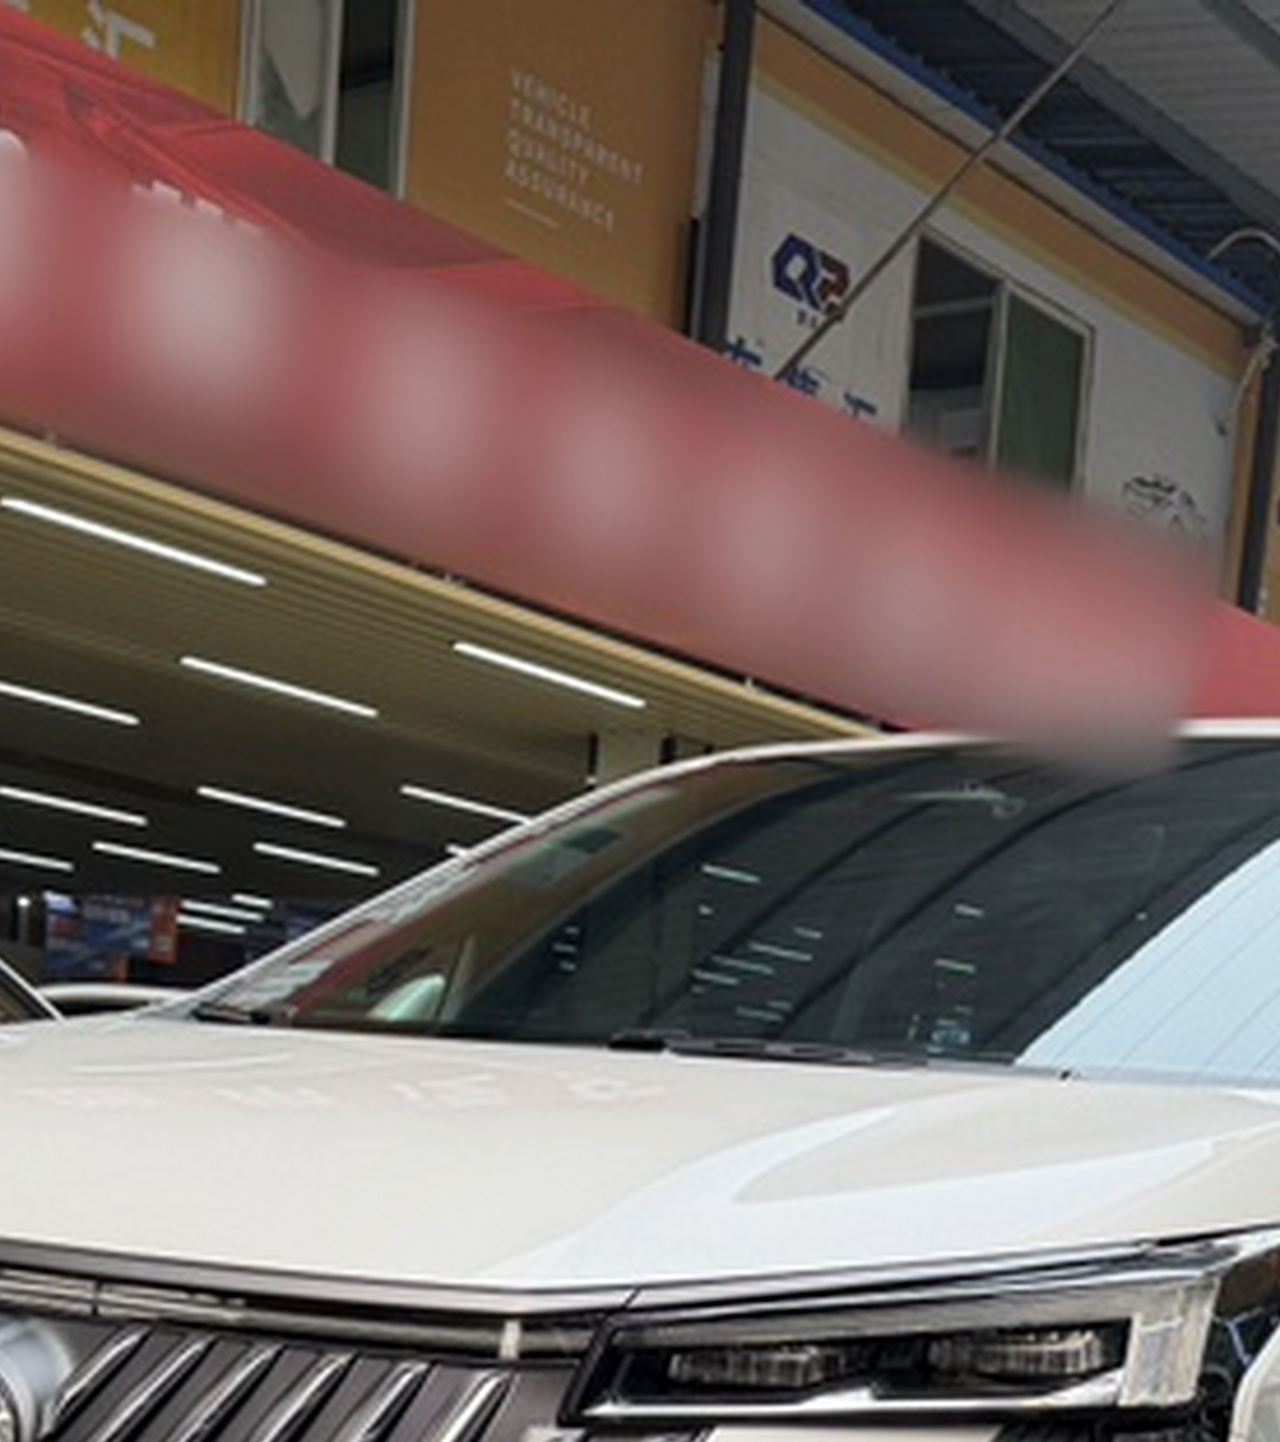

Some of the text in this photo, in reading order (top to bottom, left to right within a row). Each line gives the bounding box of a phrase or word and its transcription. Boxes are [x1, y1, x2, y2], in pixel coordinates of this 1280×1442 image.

[509, 67, 591, 131] VEHICLE
[506, 126, 590, 189] QUALITY
[509, 97, 644, 187] TRANSPARENT
[504, 157, 615, 234] ASSURANCE
